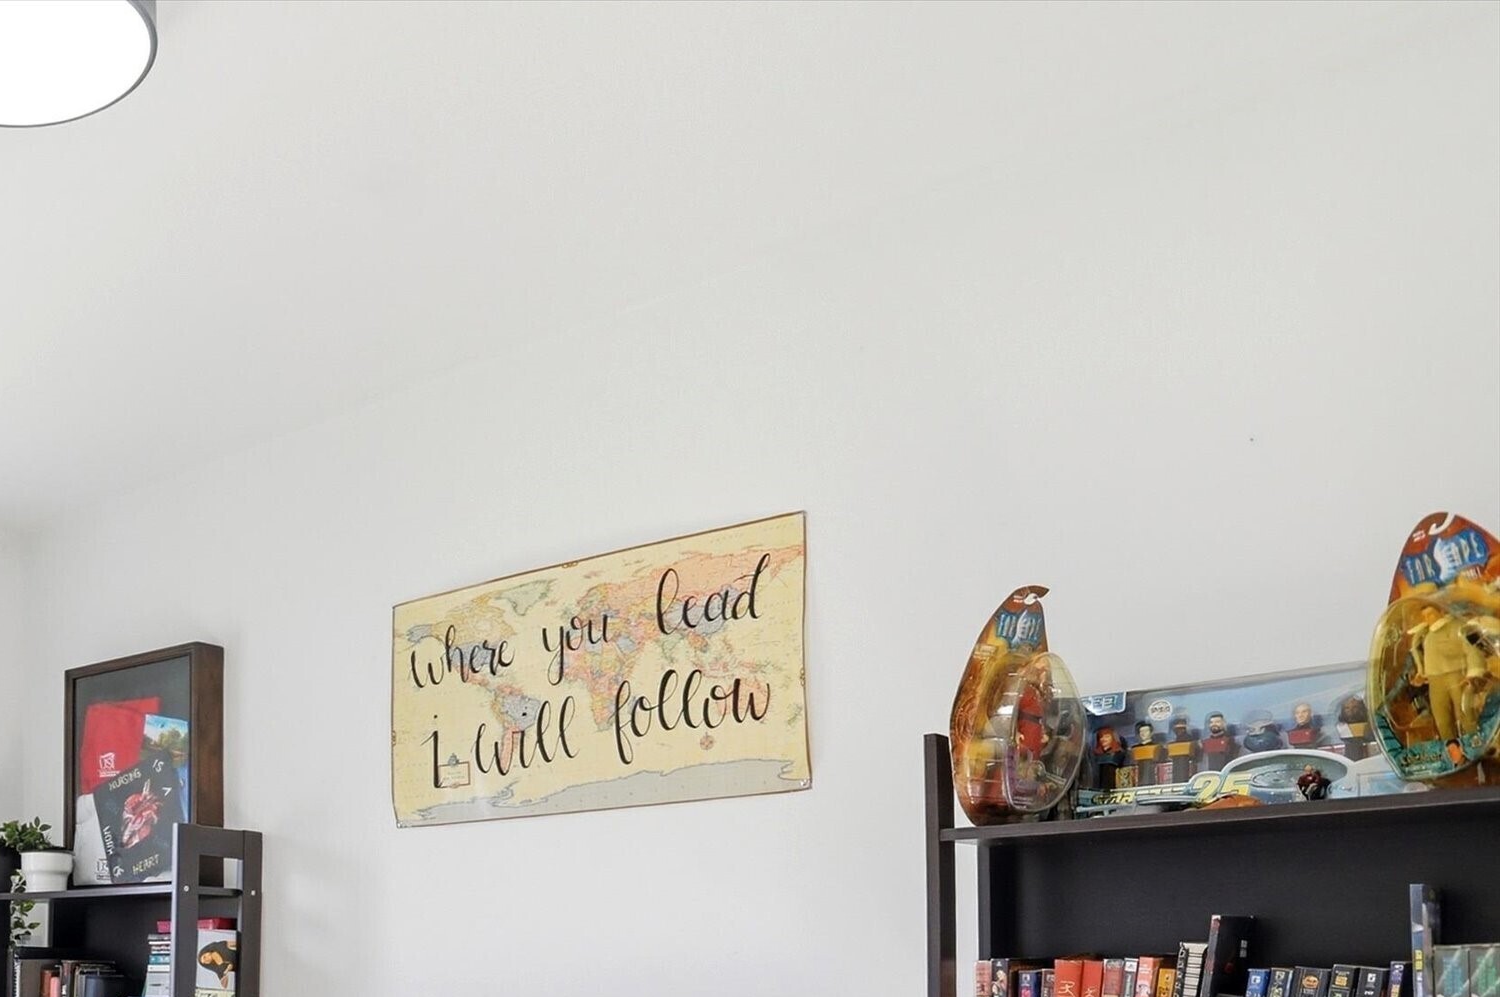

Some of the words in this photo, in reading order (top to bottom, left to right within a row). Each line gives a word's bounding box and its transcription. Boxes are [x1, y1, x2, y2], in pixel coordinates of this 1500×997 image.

[410, 625, 515, 689] where
[542, 613, 610, 686] you
[656, 553, 771, 636] lead
[420, 714, 447, 789] i
[474, 695, 580, 778] will
[613, 668, 771, 765] follow
[108, 767, 142, 791] NURSING
[152, 759, 165, 773] IS
[1192, 770, 1251, 804] 25
[132, 853, 160, 875] HEART
